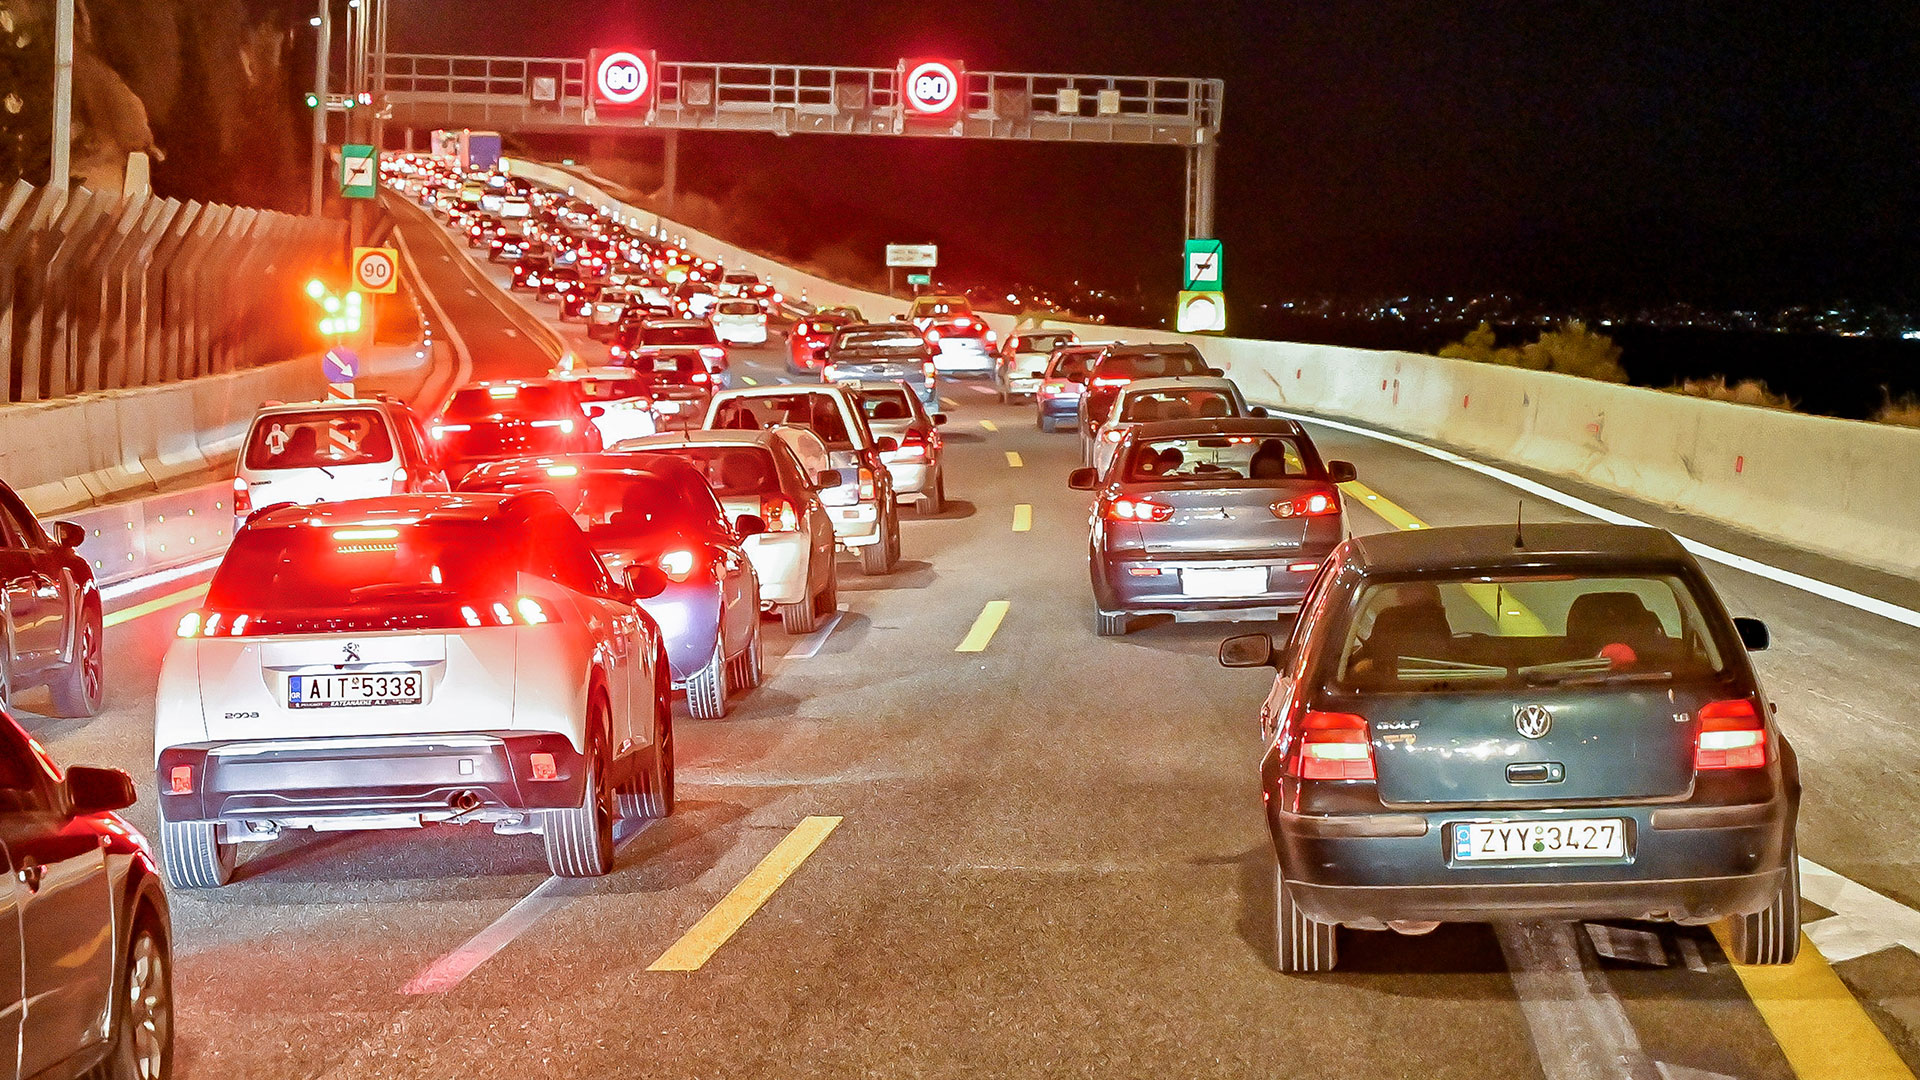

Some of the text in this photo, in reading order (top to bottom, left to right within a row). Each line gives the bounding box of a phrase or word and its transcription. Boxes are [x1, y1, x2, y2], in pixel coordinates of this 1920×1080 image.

[607, 65, 639, 90] 80
[916, 76, 948, 100] 80
[365, 263, 386, 278] 90
